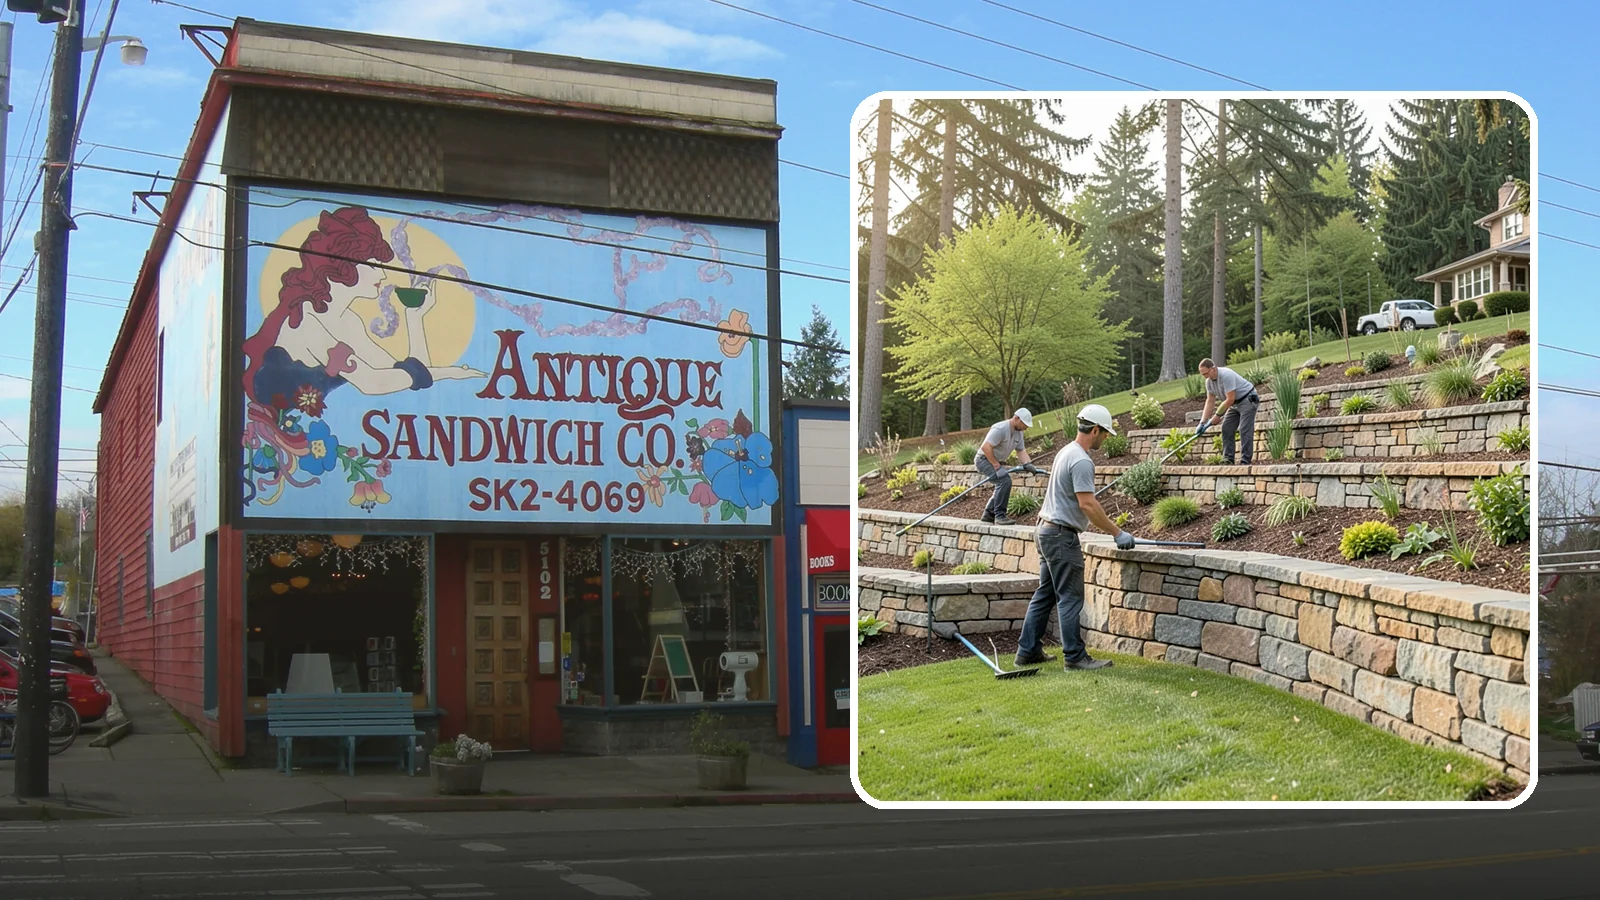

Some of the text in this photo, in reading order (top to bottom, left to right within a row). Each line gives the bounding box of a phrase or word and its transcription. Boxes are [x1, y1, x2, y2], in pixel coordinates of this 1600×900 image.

[476, 330, 723, 420] ANTIQUE
[361, 408, 686, 469] SANDWICH CO.
[468, 477, 647, 513] SK2-4069
[540, 541, 551, 599] 5102
[810, 555, 834, 568] BOOKS
